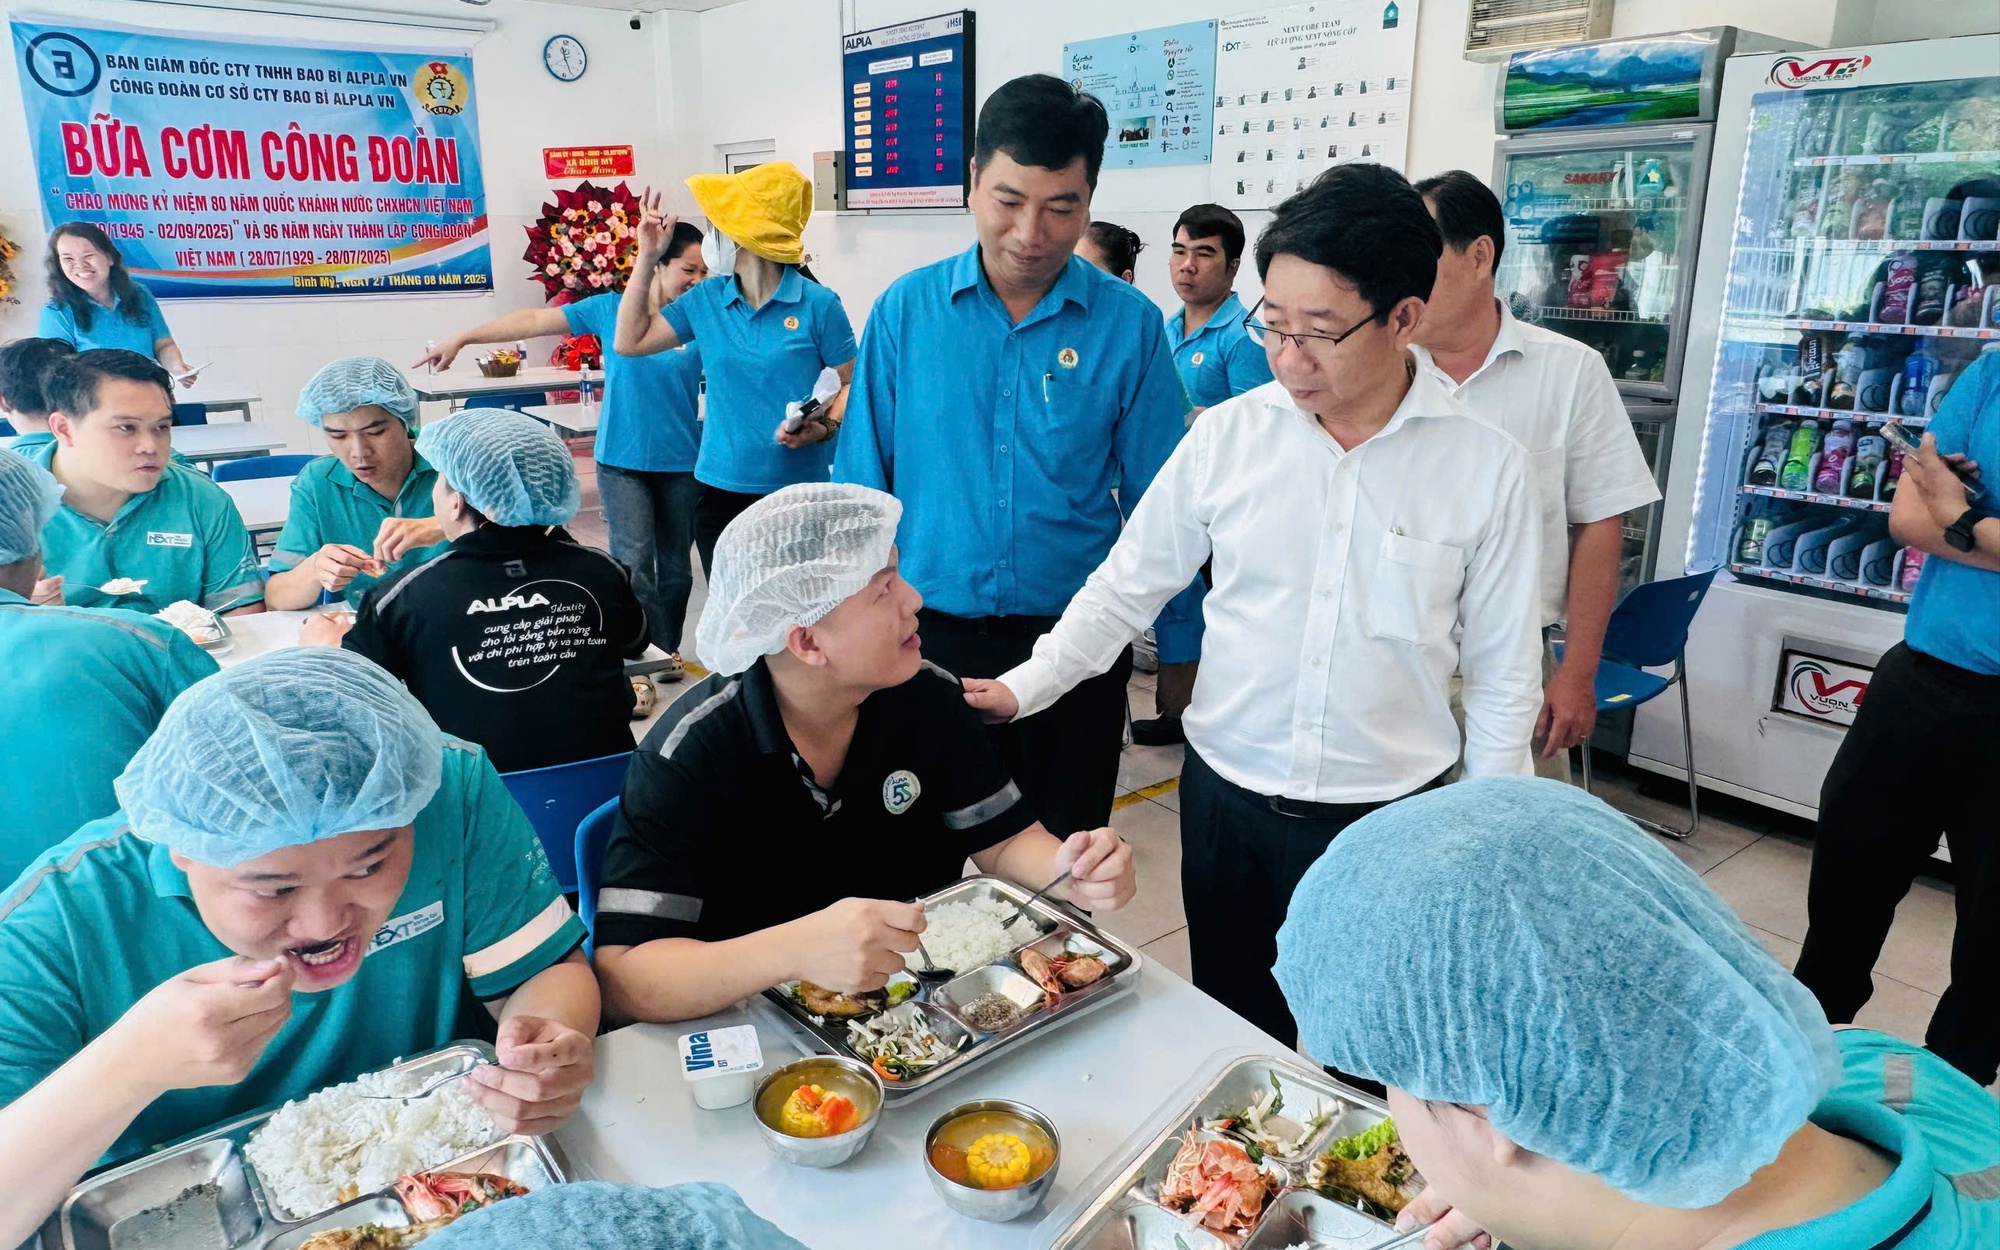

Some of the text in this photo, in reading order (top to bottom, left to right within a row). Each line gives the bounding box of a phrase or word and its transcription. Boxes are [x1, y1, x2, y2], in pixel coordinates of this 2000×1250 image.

[845, 35, 873, 50] ALPLA
[105, 54, 140, 71] BAN
[189, 56, 220, 76] ĐỐC
[224, 62, 251, 78] CTY
[254, 64, 293, 80] TNHH
[297, 68, 324, 82] BAO
[328, 67, 342, 84] BÌ
[346, 70, 386, 86] ALPLA
[389, 73, 408, 87] VN
[110, 76, 395, 108] CÔNG ĐOÀN CƠ SỞ CTY BAO BÌ ALPLA VN
[60, 113, 461, 185] BỮA CƠM CÔNG ĐOÀN
[108, 191, 149, 211] MỪNG
[153, 188, 169, 211] KỶ
[173, 191, 207, 215] NIỆM
[211, 195, 227, 212] 80
[229, 193, 260, 212] NĂM
[263, 190, 295, 213] QUỐC
[298, 193, 339, 213] KHÁNH
[342, 194, 373, 213] NƯỚC
[376, 198, 421, 213] CHXHCN
[423, 194, 446, 216] VIỆT
[449, 198, 474, 213] NAM
[244, 222, 261, 239] VÀ
[264, 224, 278, 239] 96
[282, 220, 309, 239] NĂM
[313, 220, 343, 239] NGÀY
[348, 221, 384, 239] THÀNH
[387, 222, 407, 242] LẬP
[411, 221, 441, 240] CÔNG
[176, 248, 202, 270] VIỆT
[207, 250, 237, 267] NAM
[250, 251, 314, 266] 28/07/1929
[326, 250, 391, 266] 28/07/2025)
[373, 275, 385, 287] 27
[388, 273, 422, 286] THÁNG
[424, 274, 436, 286] 08
[464, 273, 487, 285] 2025
[466, 592, 551, 615] ALPLA
[484, 623, 511, 635] cung
[513, 619, 532, 631] cấp
[555, 613, 582, 626] pháp
[481, 637, 501, 648] cho
[518, 630, 544, 641] sống
[468, 651, 484, 663] với
[486, 648, 502, 659] chi
[525, 642, 546, 653] hợp
[573, 638, 585, 646] an
[507, 648, 577, 668] trên toàn cầu
[685, 1031, 715, 1072] Vina
